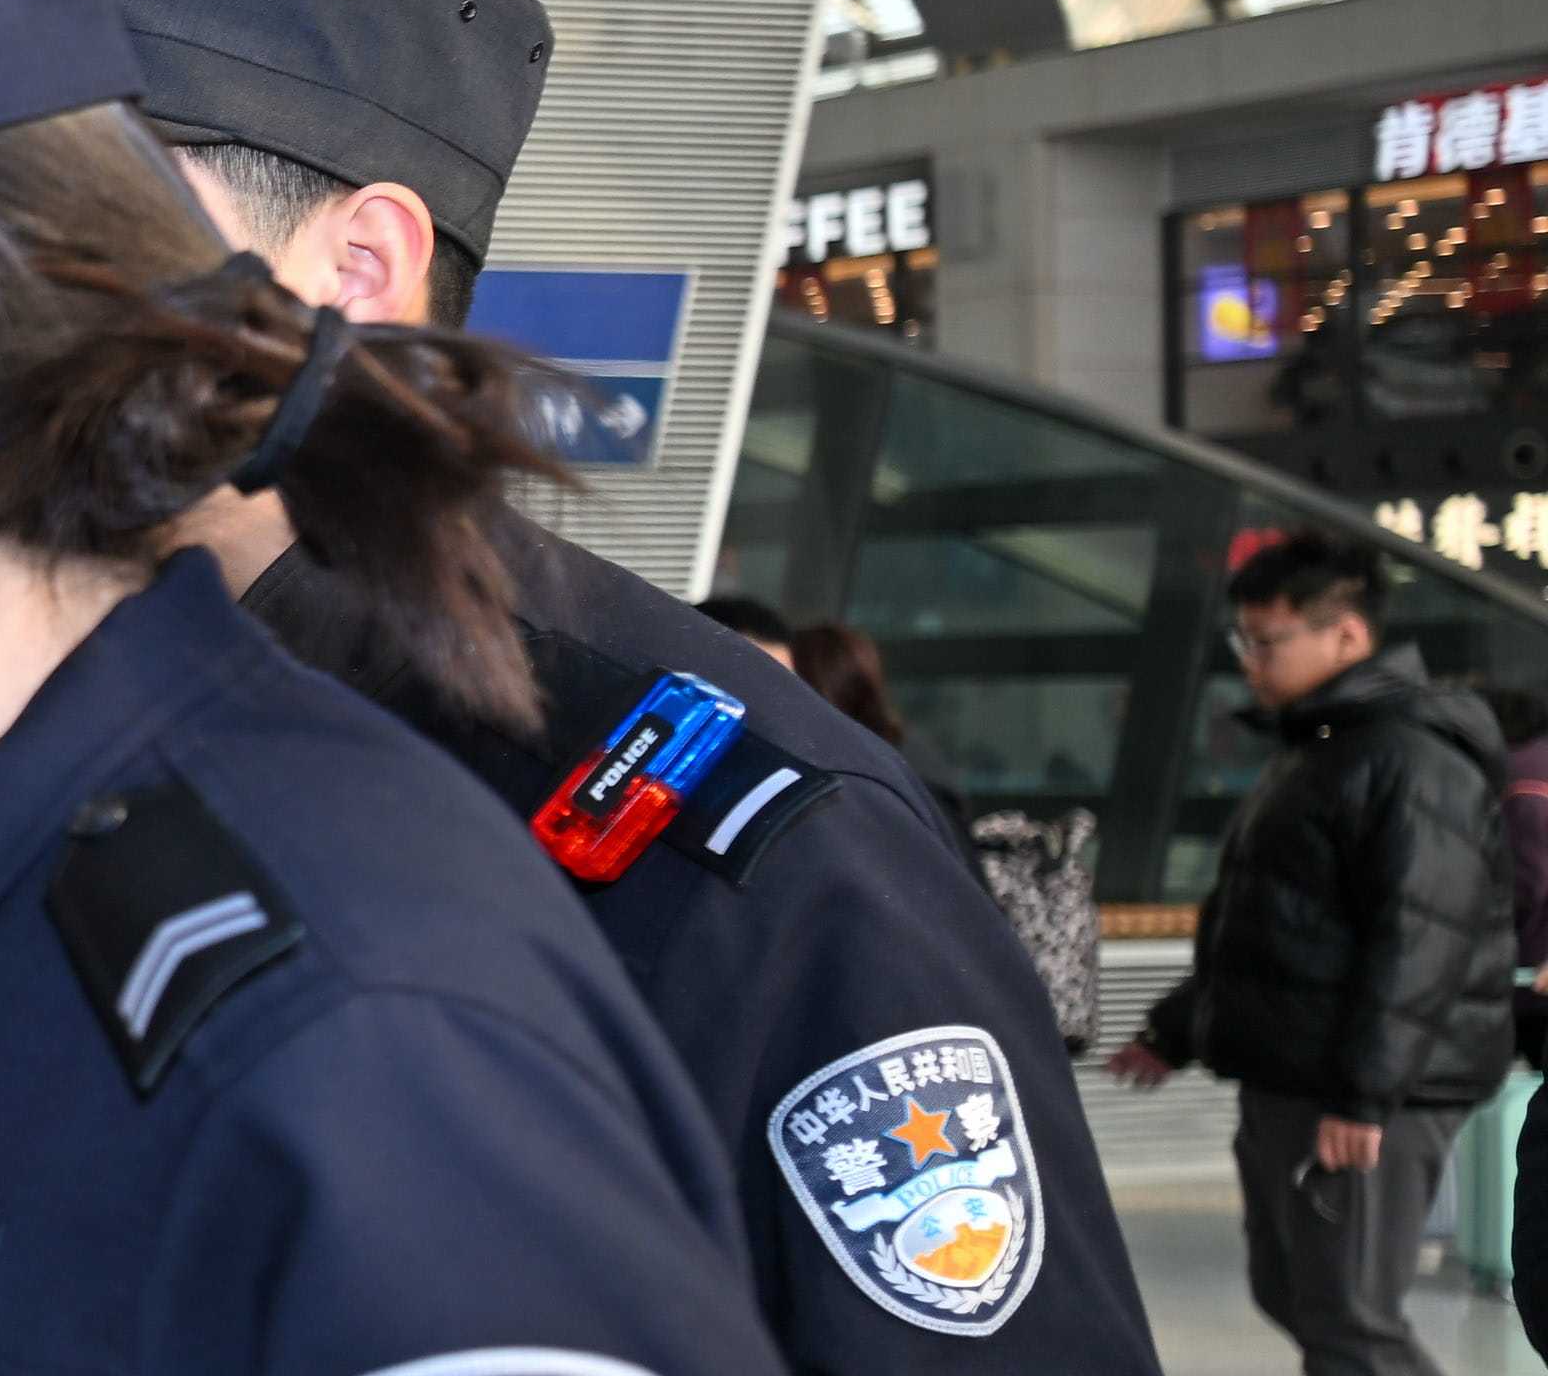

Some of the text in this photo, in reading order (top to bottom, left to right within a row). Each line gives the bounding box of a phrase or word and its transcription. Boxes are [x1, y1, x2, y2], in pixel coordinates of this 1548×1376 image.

[588, 727, 659, 802] POLICE
[788, 1046, 993, 1148] 中华人民共和国
